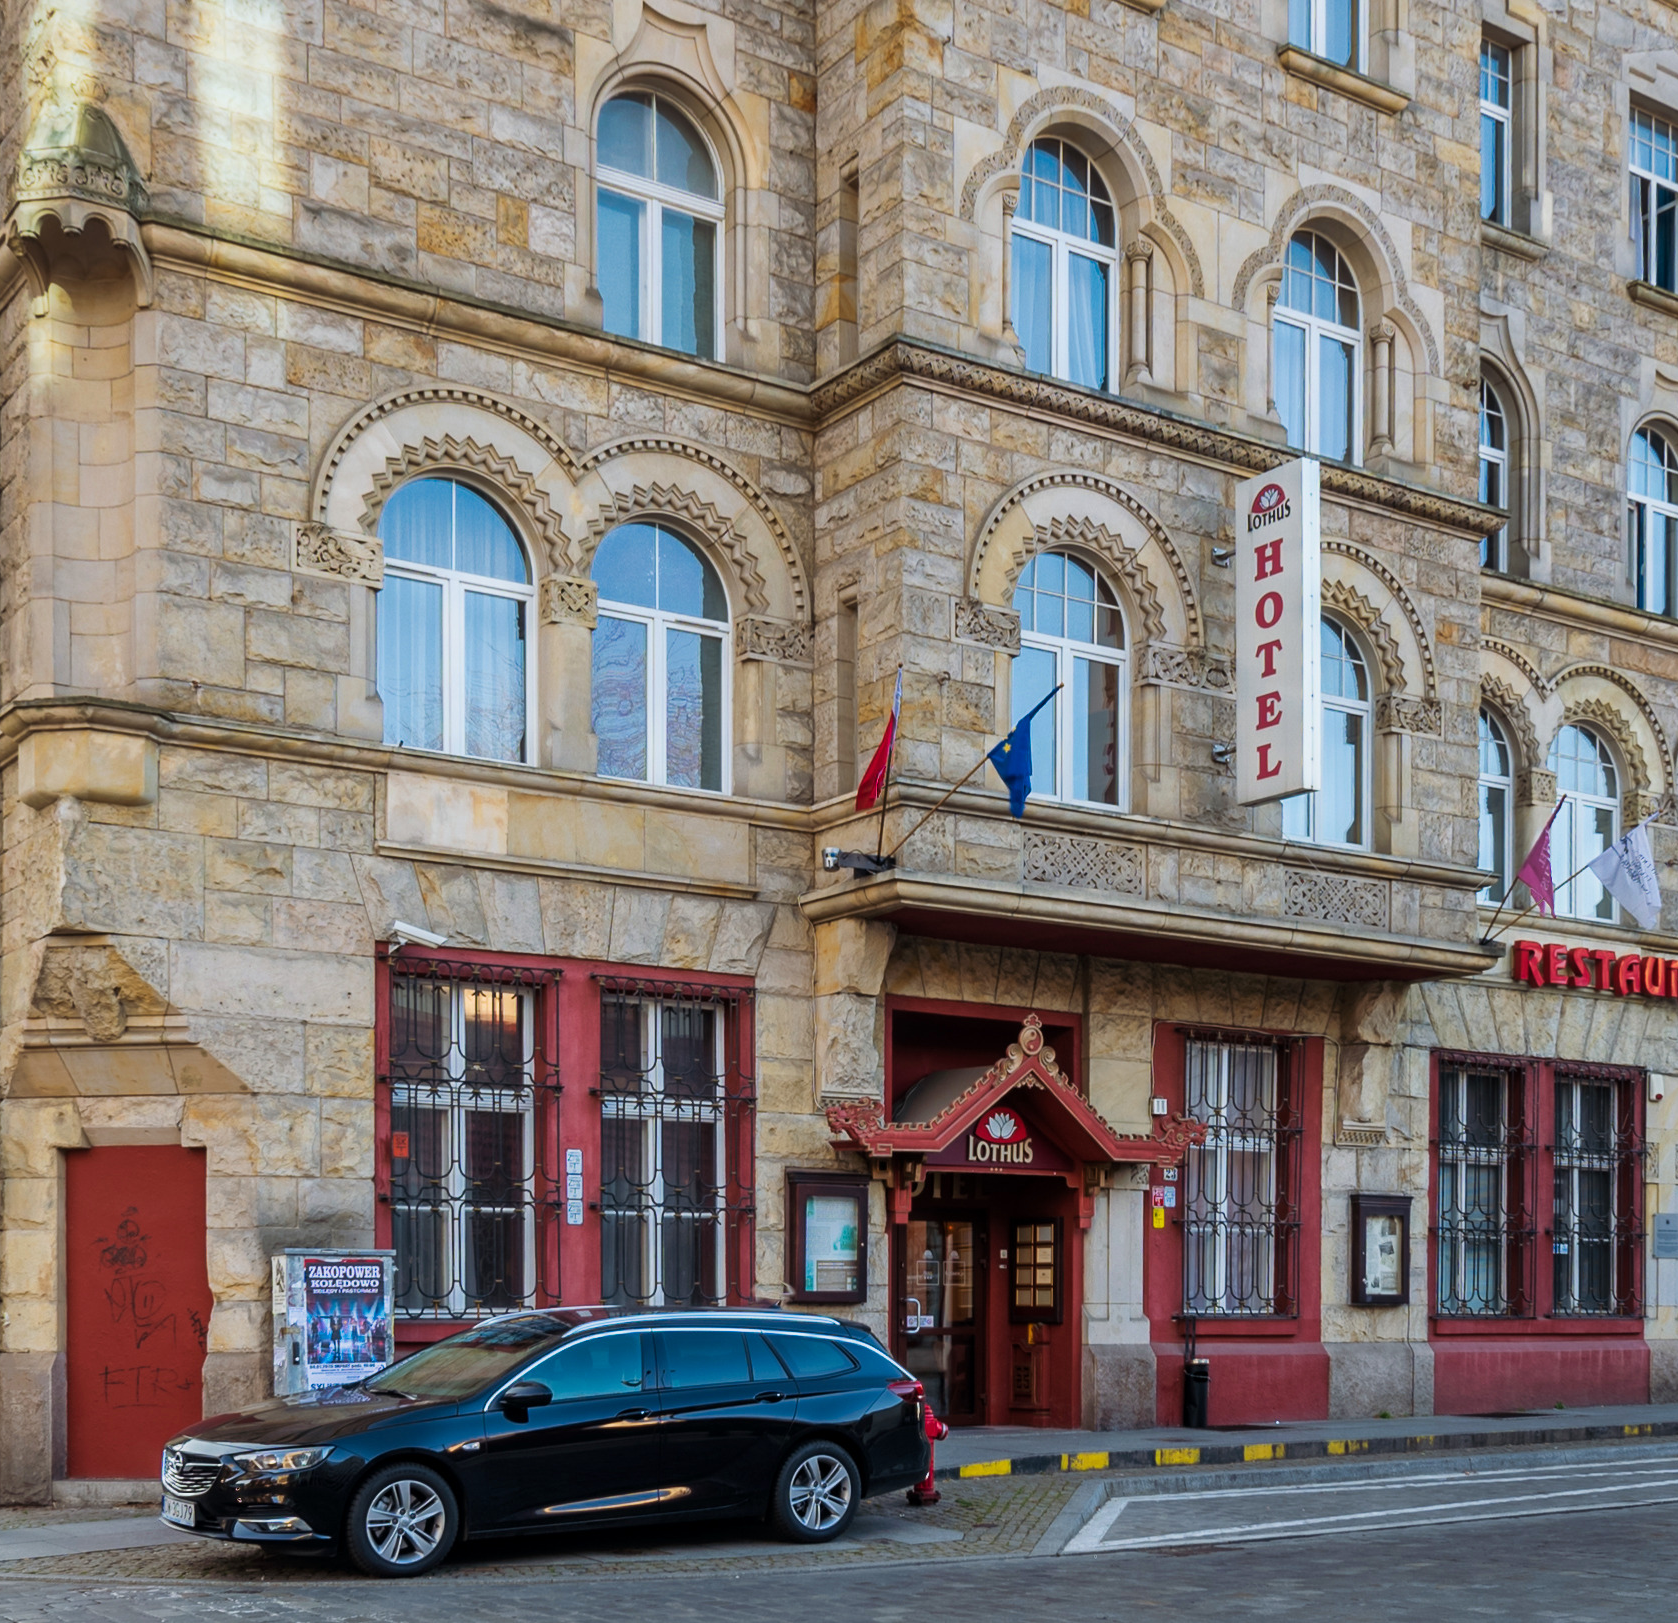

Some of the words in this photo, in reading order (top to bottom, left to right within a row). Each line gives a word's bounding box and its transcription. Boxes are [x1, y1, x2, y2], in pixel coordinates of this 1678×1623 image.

[1247, 498, 1291, 533] LOTHUS
[1254, 538, 1284, 781] HOTEL
[968, 1135, 1034, 1163] LOTHUS
[308, 1265, 381, 1279] ZAKOPOWER
[310, 1279, 380, 1289] KOLĘDOWO
